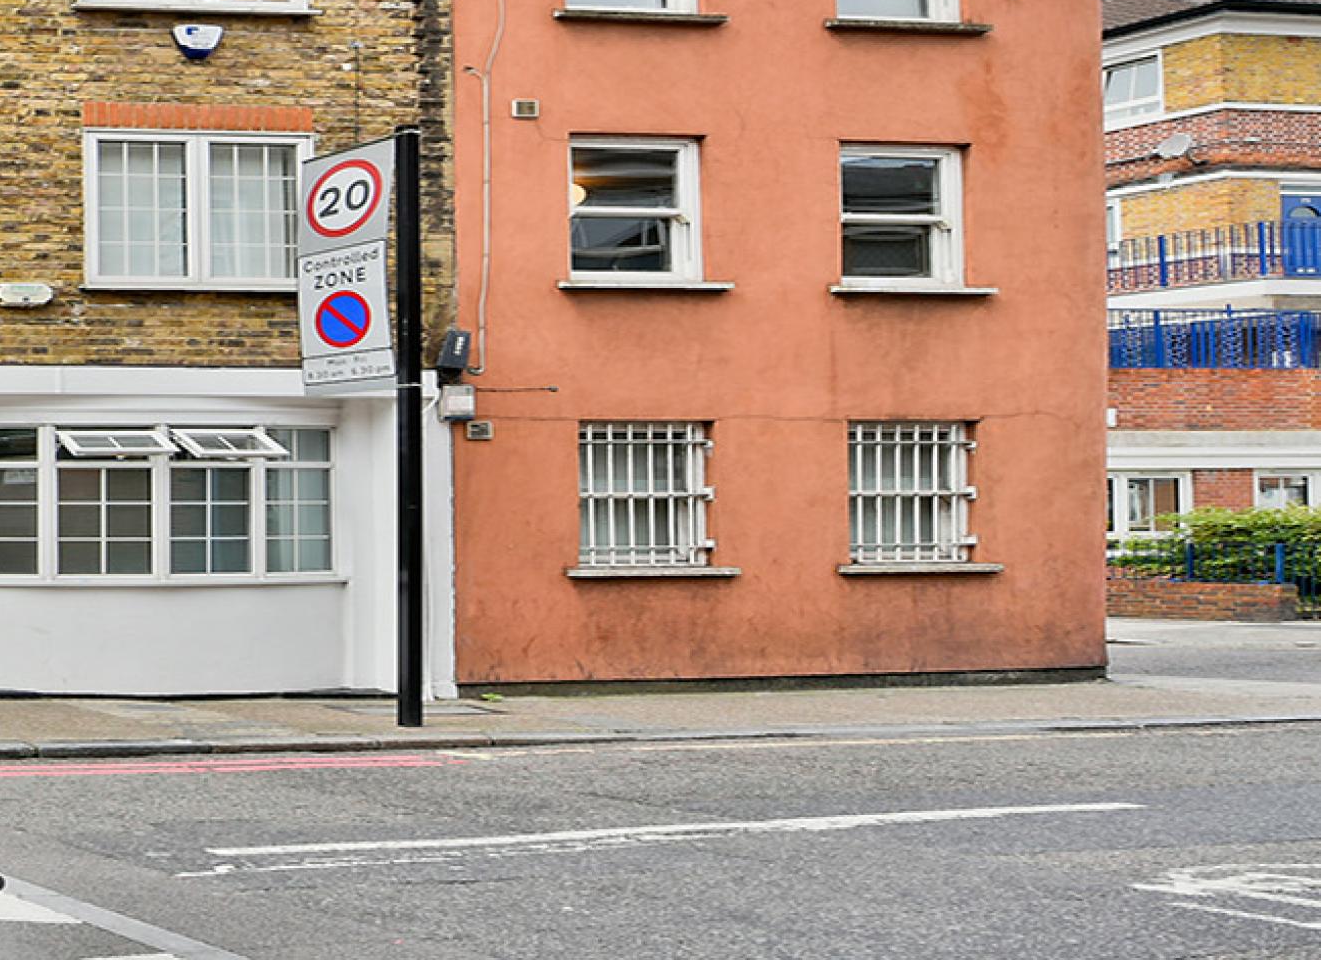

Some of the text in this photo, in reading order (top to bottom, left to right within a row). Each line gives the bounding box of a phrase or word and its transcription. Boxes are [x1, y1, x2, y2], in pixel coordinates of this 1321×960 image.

[319, 179, 369, 218] 20
[303, 248, 378, 273] Controlled
[314, 267, 366, 289] ZONE
